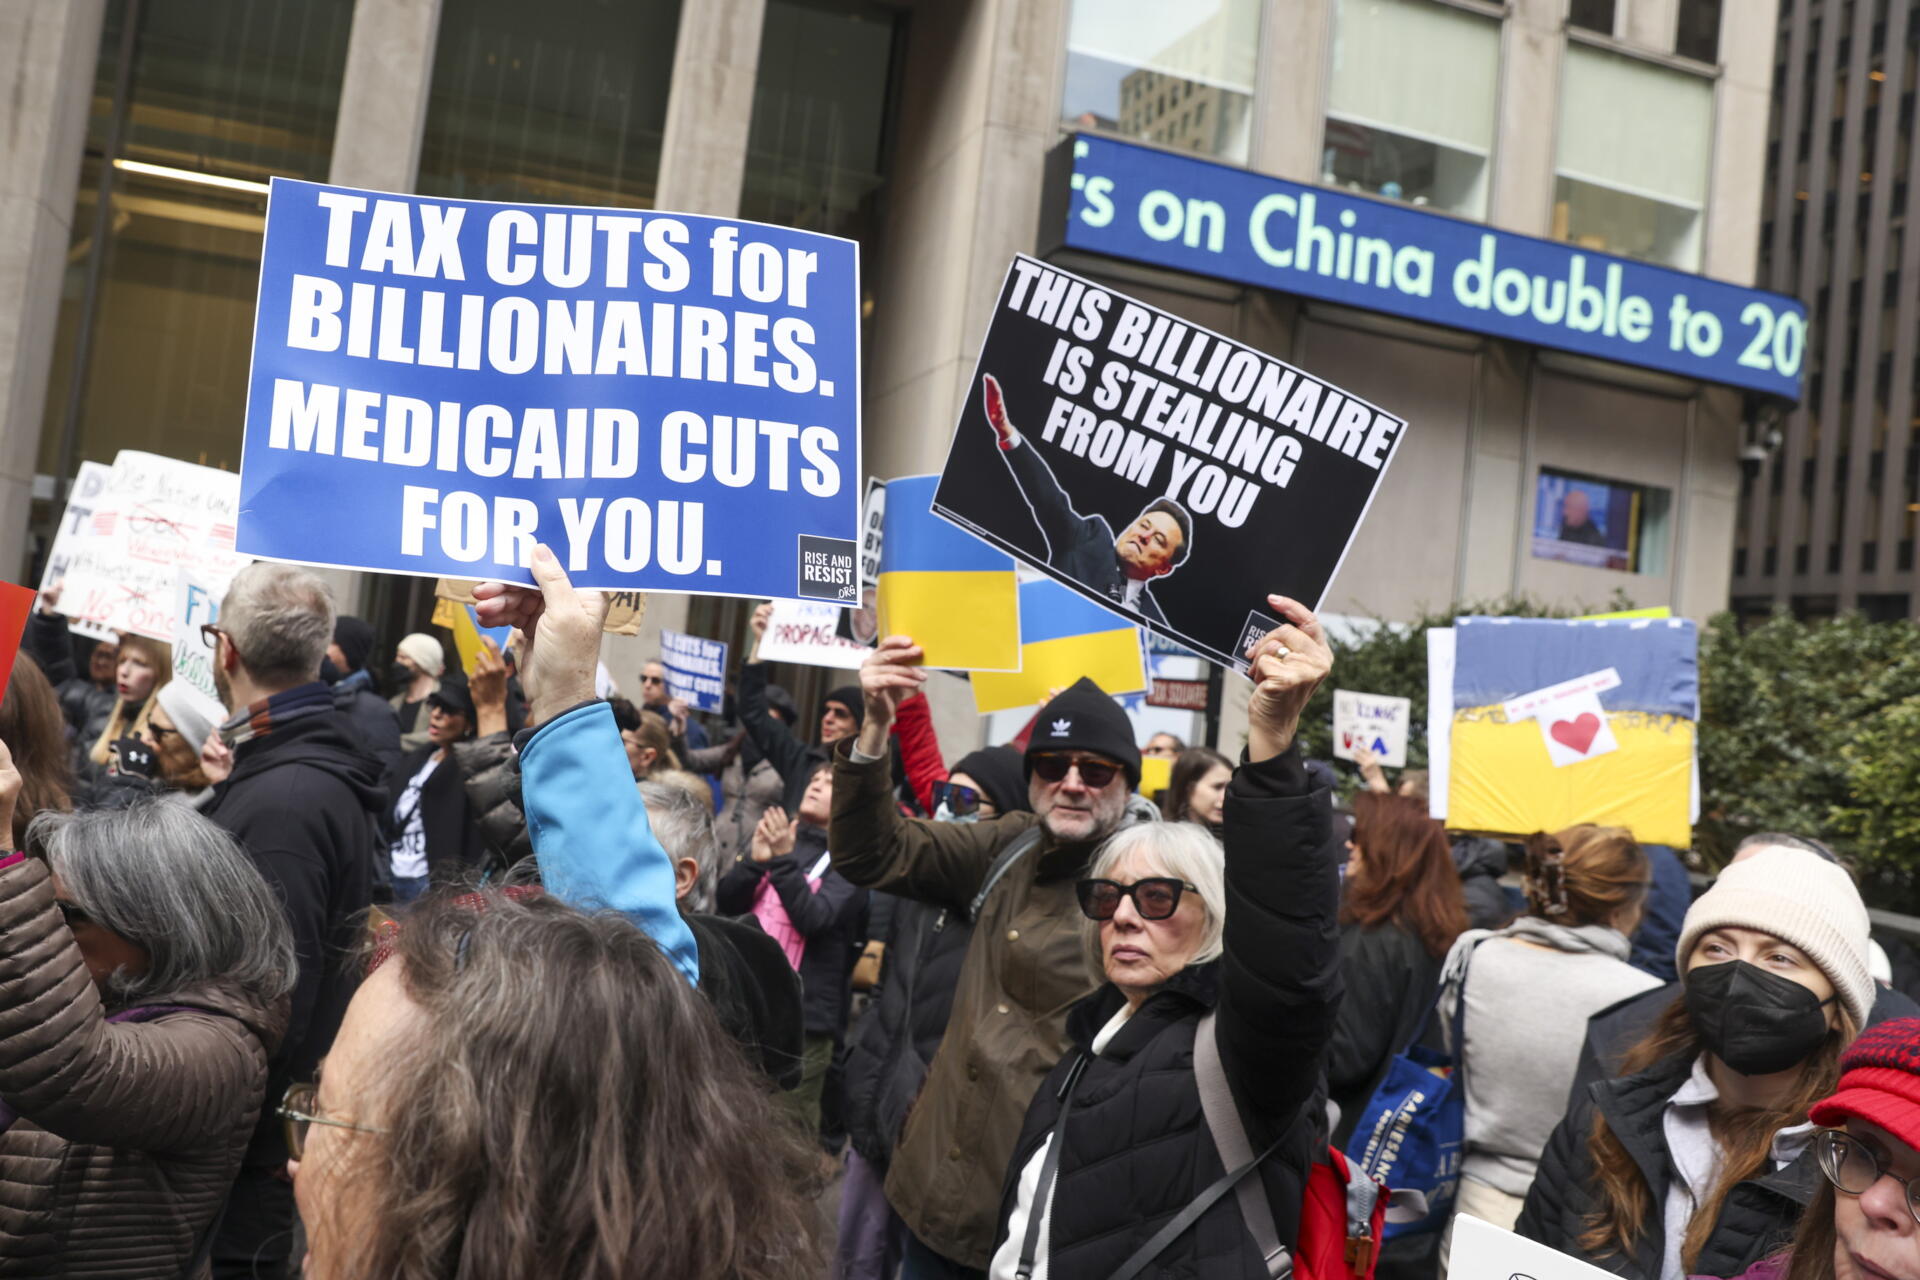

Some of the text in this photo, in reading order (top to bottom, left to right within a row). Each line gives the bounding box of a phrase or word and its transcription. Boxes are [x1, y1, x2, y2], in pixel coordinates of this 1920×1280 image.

[318, 191, 818, 309] TAX CUTS for
[1138, 190, 1226, 253] on
[1248, 192, 1435, 298] China
[1452, 233, 1653, 343] double
[1669, 293, 1724, 358] to
[1737, 302, 1808, 378] 20
[286, 274, 835, 397] BILLIONAIRES.
[1007, 259, 1399, 470] THIS BILLIONAIRE
[268, 378, 840, 498] MEDICAID CUTS
[1041, 396, 1261, 528] FROM YOU
[1042, 338, 1303, 489] IS STEALING
[400, 484, 722, 576] FOR YOU.
[804, 551, 852, 568] RISE AND
[804, 564, 852, 585] RESIST
[773, 623, 872, 650] PROPAG
